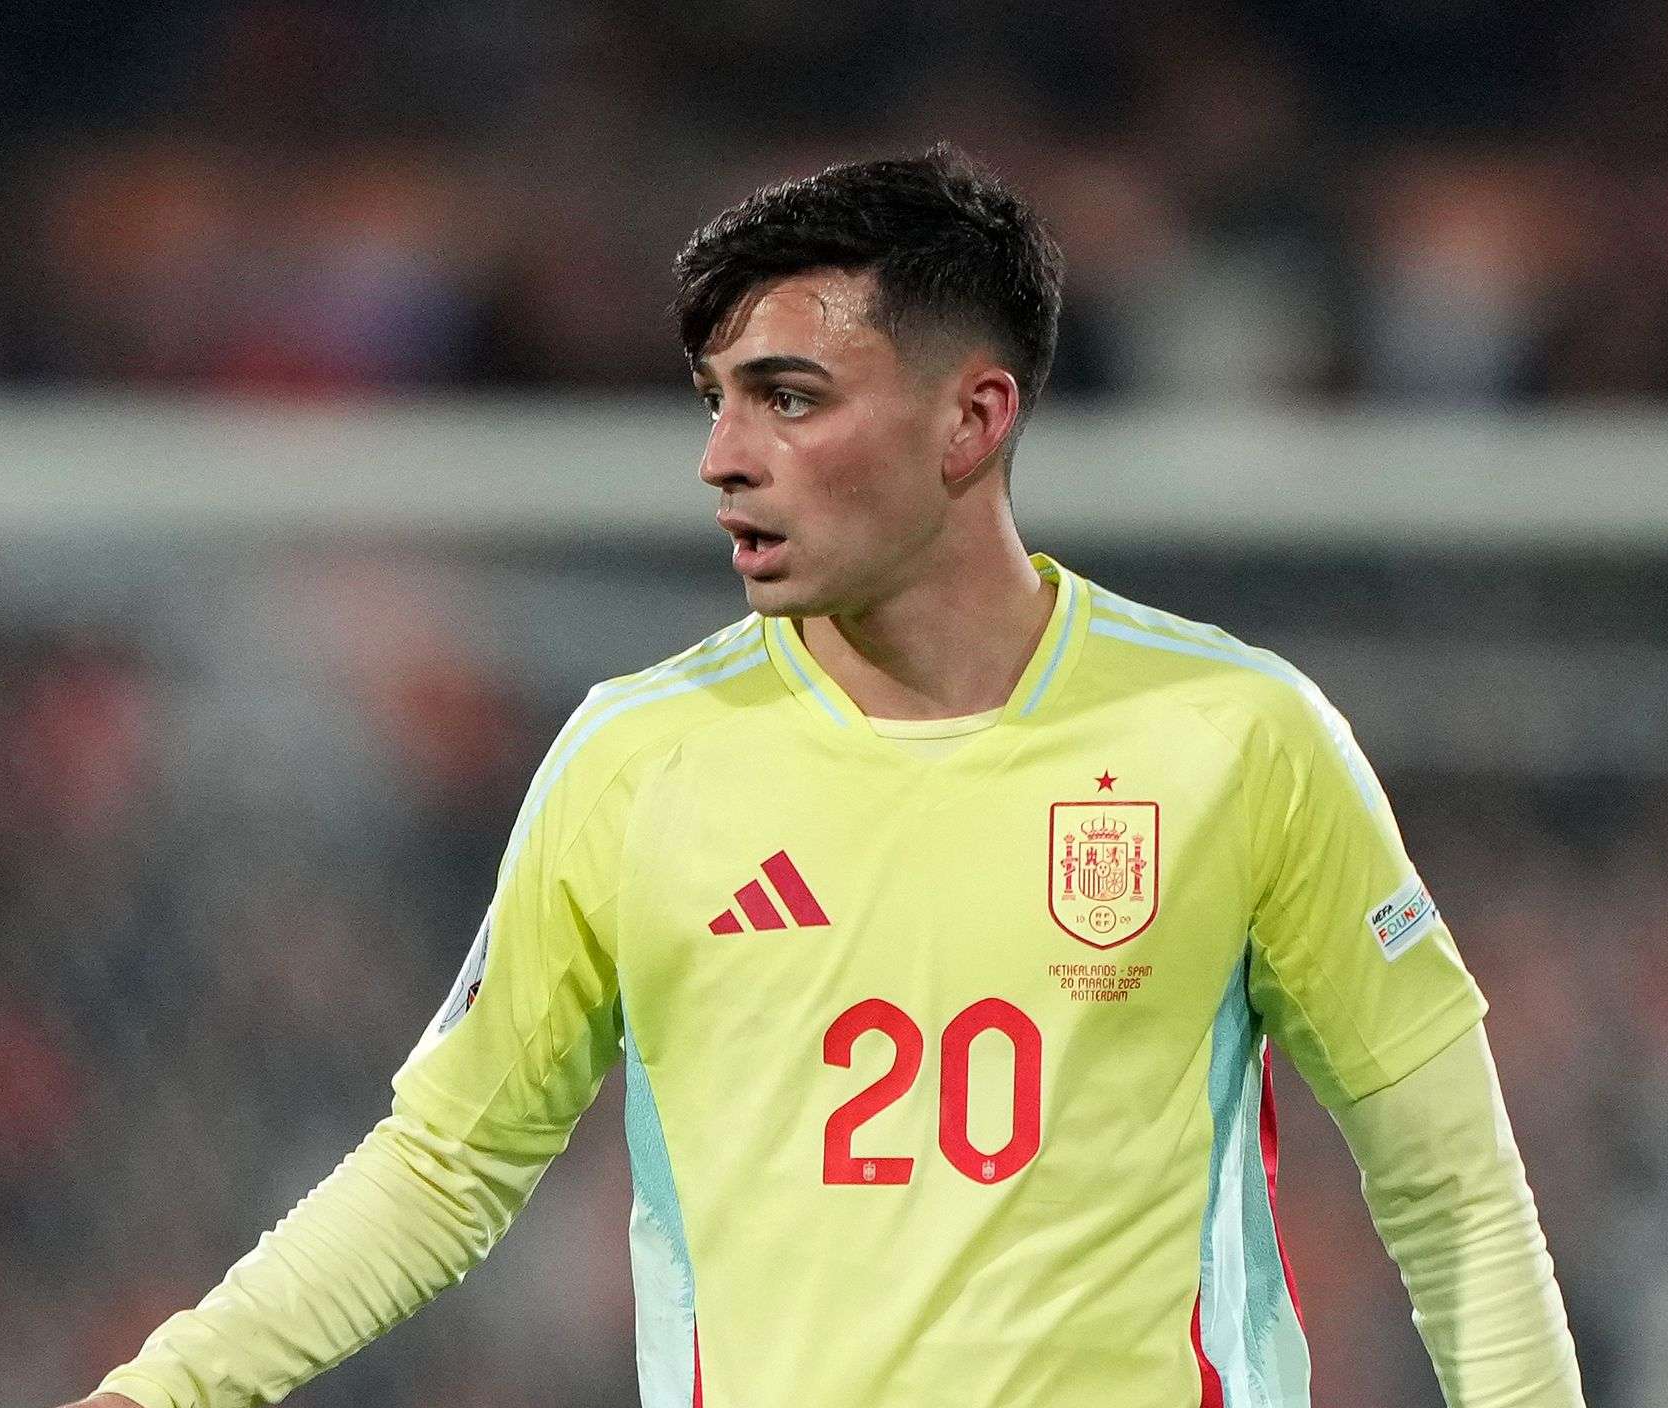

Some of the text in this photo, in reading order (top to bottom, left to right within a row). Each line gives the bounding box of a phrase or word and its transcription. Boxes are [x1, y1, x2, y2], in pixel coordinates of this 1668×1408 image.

[1372, 904, 1393, 925] UEFA
[1048, 964, 1117, 976] NETHERLANDS
[1127, 965, 1153, 977] SPAIN
[1060, 977, 1141, 989] 20 MARCH 2025
[1071, 990, 1128, 1002] ROTTERDAM
[823, 998, 1042, 1185] 20
